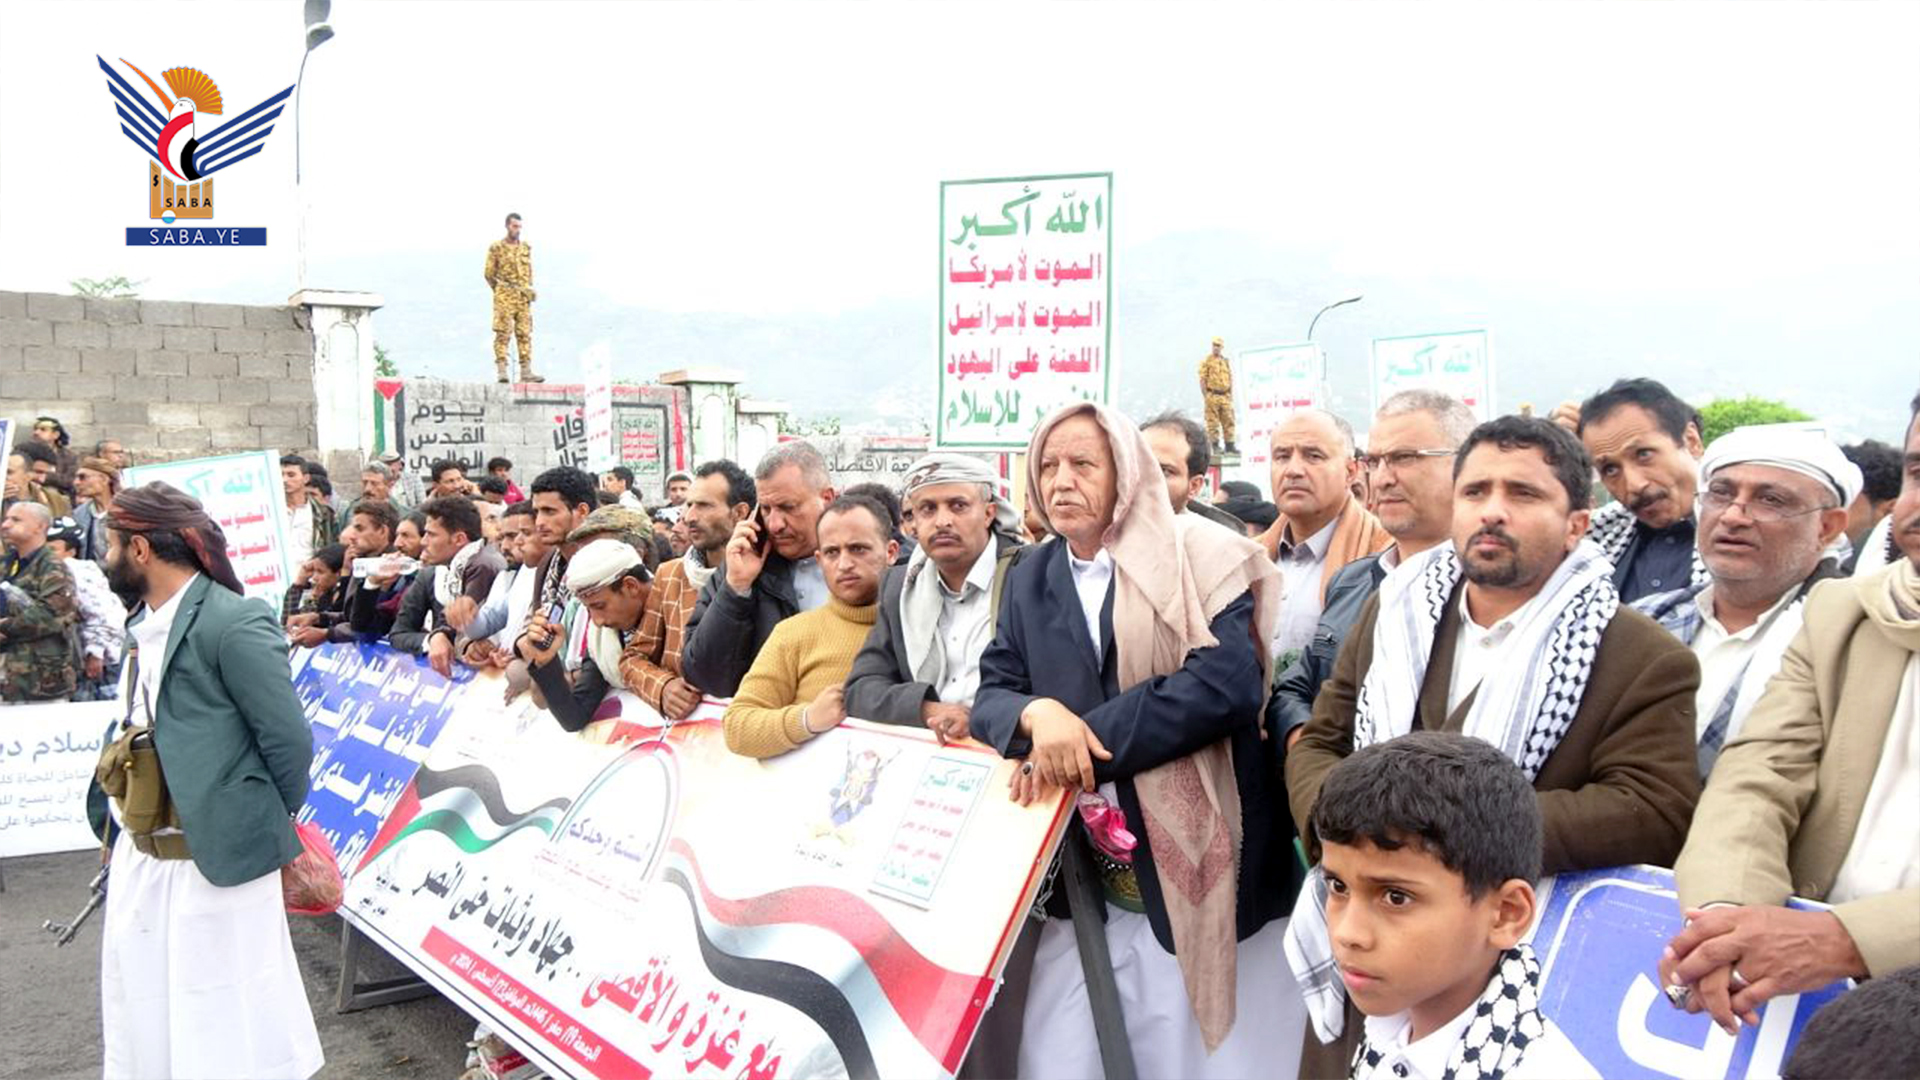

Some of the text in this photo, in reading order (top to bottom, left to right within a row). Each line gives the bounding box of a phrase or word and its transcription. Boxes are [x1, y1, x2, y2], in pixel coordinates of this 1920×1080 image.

[949, 184, 1103, 251] الله أكبر
[949, 246, 1102, 290] الموت لأمريكا
[1033, 300, 1101, 335] الموت
[947, 345, 1100, 381] اللعنة على اليهود
[411, 402, 485, 425] يوم
[946, 388, 1021, 437] للإسلام
[409, 426, 485, 451] القدس
[411, 860, 466, 899] النصر
[682, 990, 744, 1074] غزة
